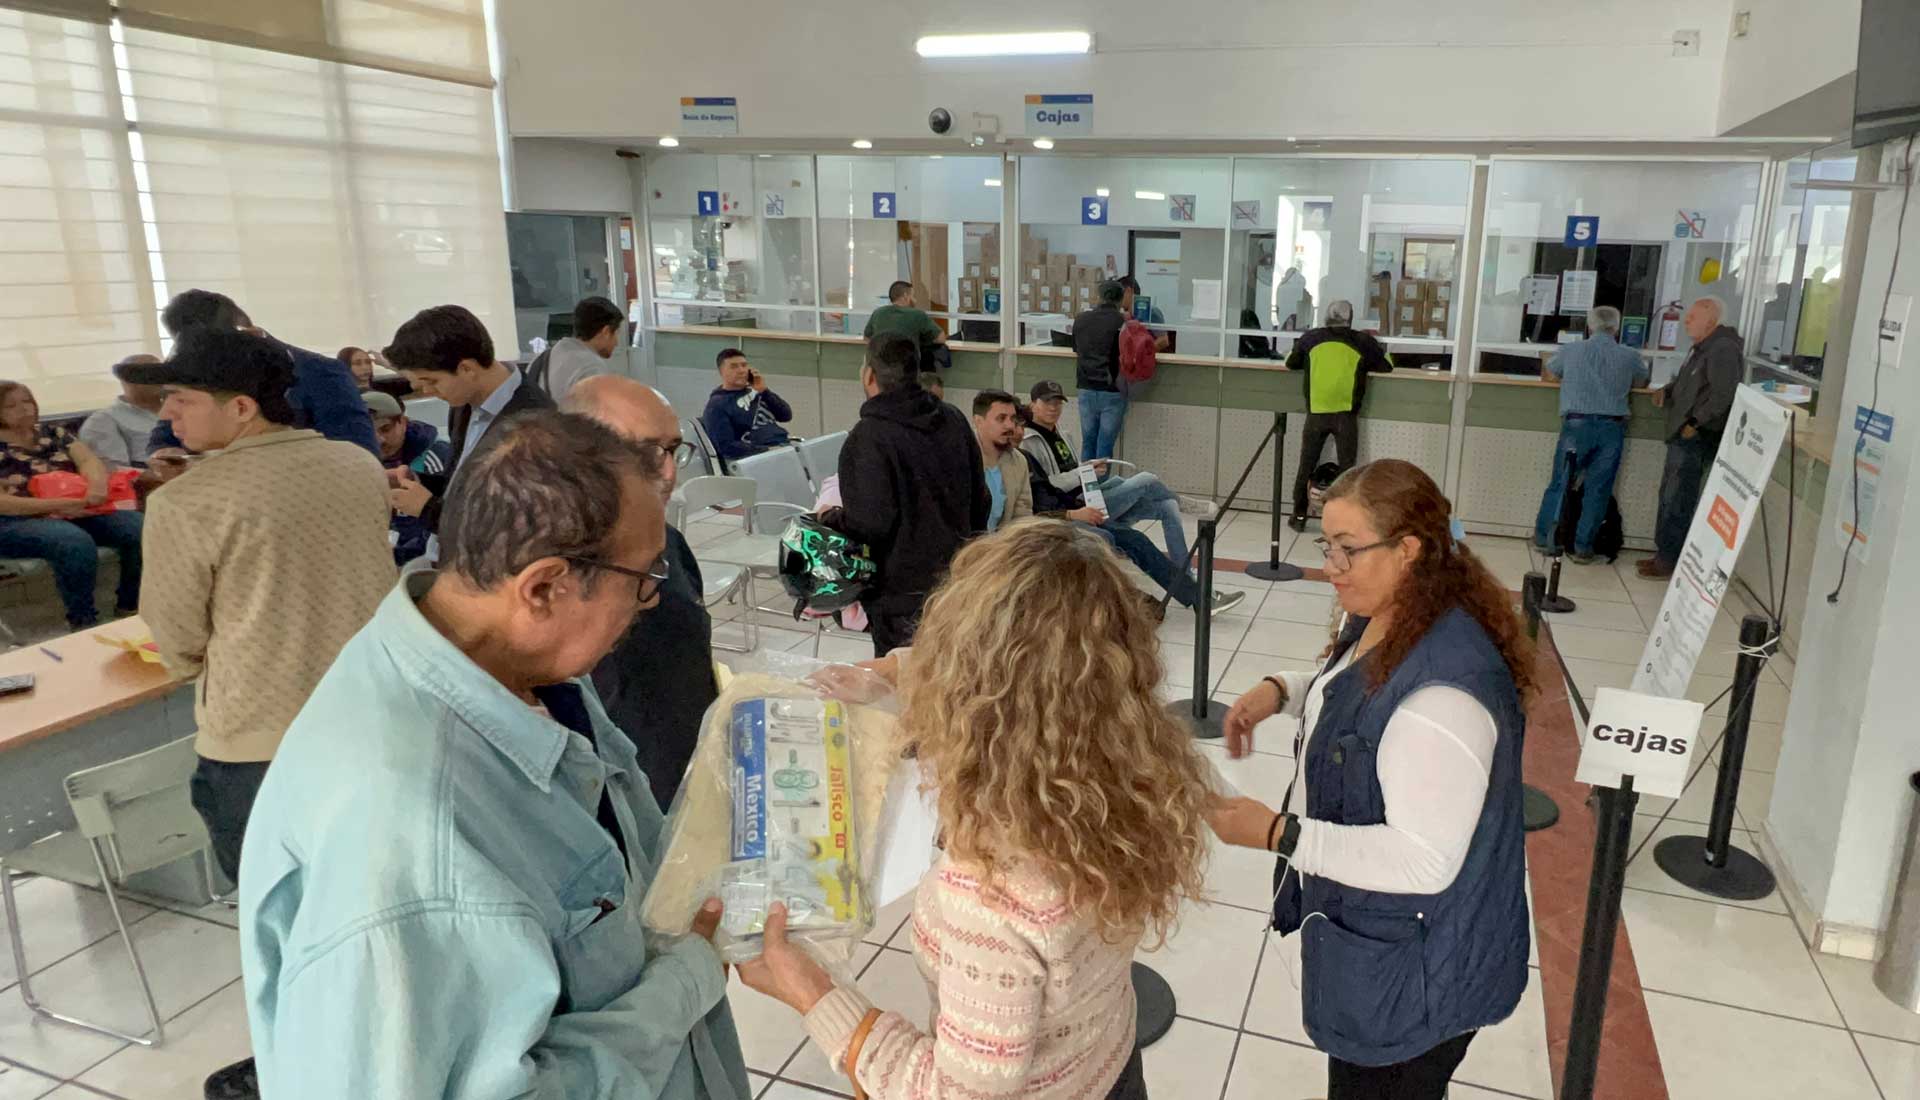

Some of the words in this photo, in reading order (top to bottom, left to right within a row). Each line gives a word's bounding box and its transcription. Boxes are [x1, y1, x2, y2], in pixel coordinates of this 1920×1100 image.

[1036, 109, 1080, 126] Cajas
[703, 196, 712, 211] 1
[879, 197, 890, 213] 2
[1088, 202, 1101, 220] 3
[1573, 221, 1590, 240] 5
[1592, 724, 1688, 755] cajas
[830, 765, 844, 822] Jalisco
